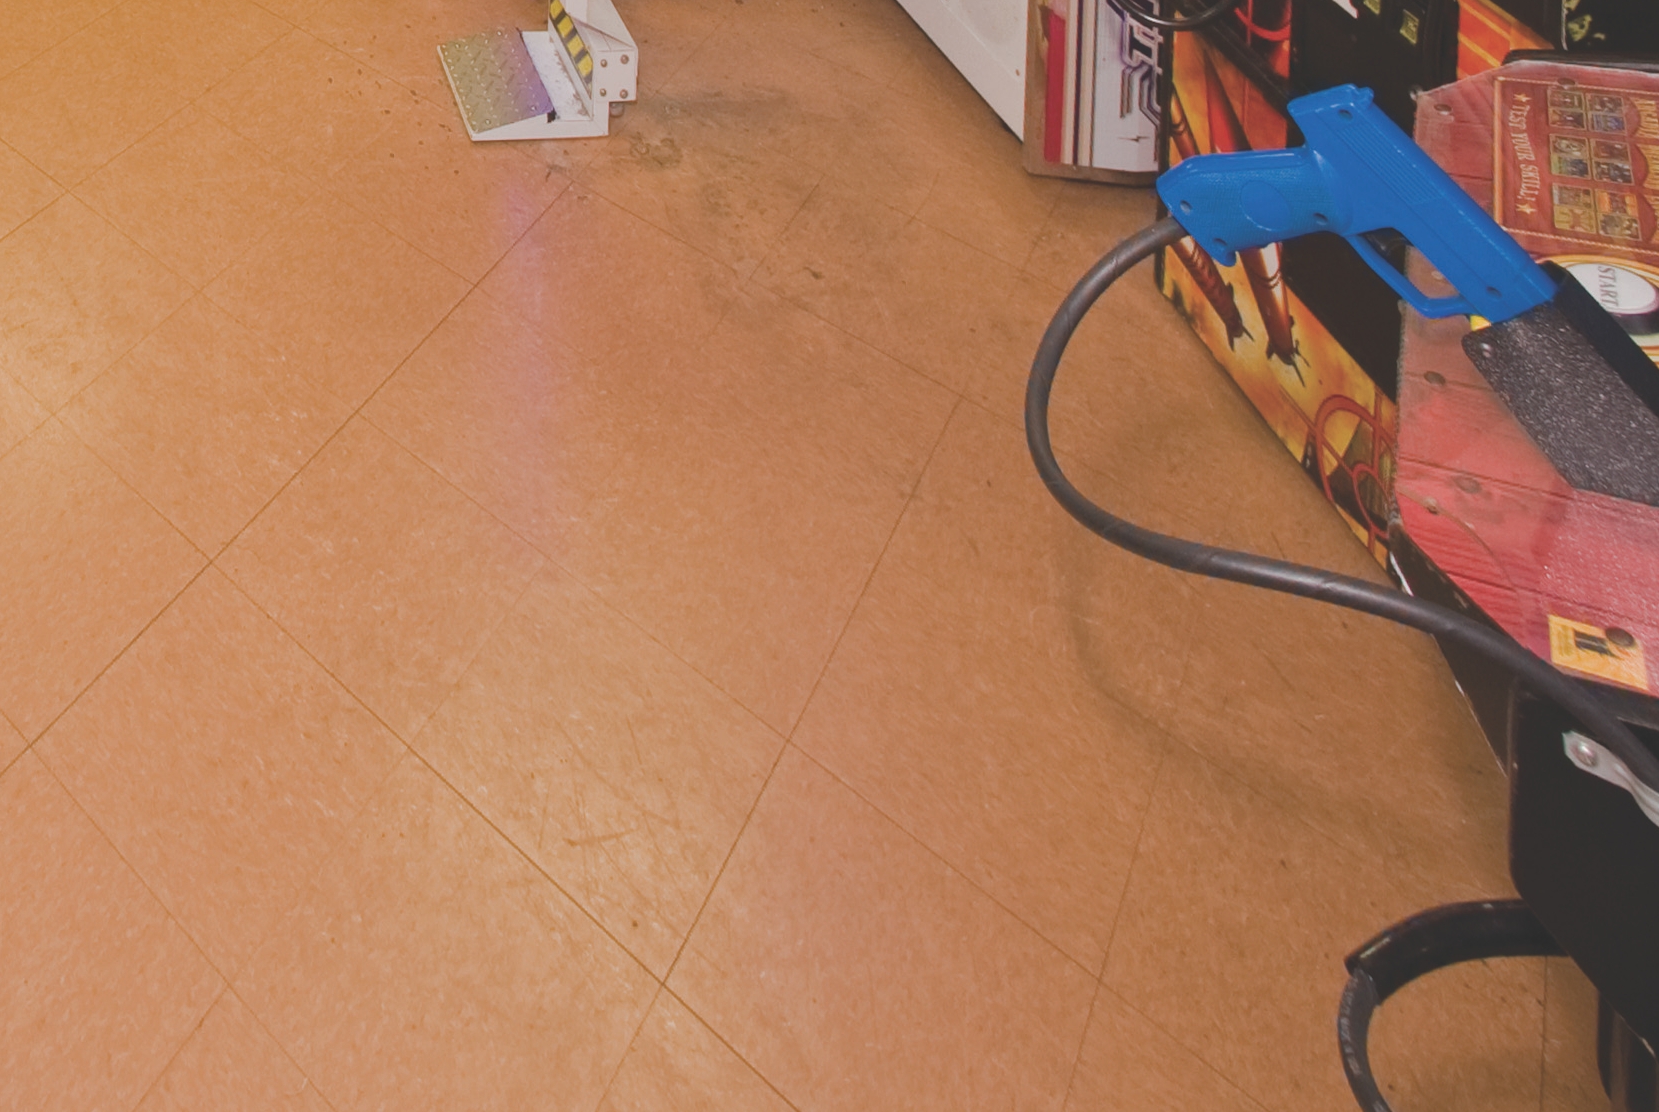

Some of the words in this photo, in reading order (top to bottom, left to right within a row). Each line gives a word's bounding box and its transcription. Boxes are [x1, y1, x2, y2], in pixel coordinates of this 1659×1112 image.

[1508, 105, 1531, 130] TEST
[1510, 132, 1536, 161] YOUR
[1516, 163, 1541, 202] SKILL!
[1597, 264, 1620, 308] START
